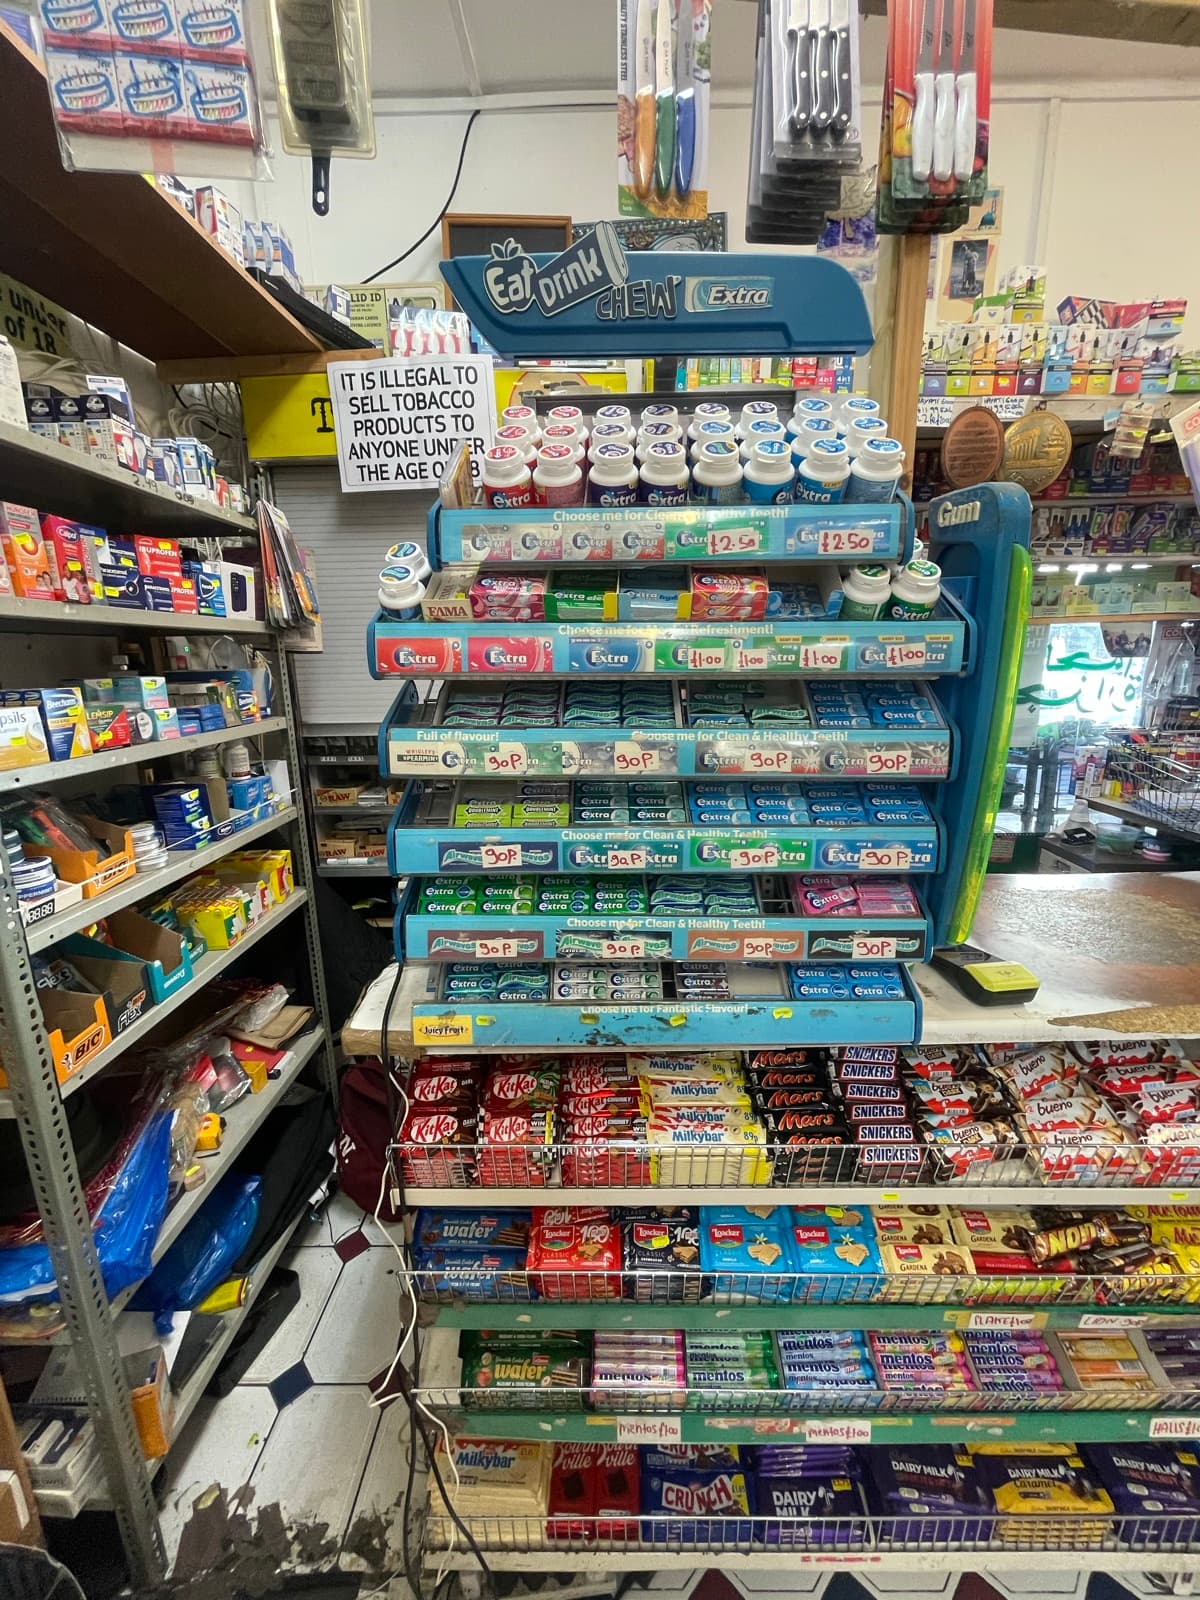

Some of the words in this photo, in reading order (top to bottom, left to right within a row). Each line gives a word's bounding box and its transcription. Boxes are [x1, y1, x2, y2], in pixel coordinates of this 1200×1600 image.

[486, 260, 534, 306] Eat
[538, 248, 603, 308] Drink
[351, 293, 367, 302] LID
[371, 293, 382, 302] ID
[596, 275, 682, 320] CHEW
[707, 285, 769, 306] Extra
[4, 316, 25, 341] of
[341, 373, 357, 391] IT
[361, 371, 376, 390] IS
[380, 366, 451, 388] ILLEGAL
[454, 365, 478, 386] TO
[349, 396, 390, 415] SELL
[392, 390, 475, 412] TOBACCO
[353, 415, 446, 437] PRODUCTS
[450, 413, 475, 433] TO
[349, 439, 420, 460] ANYONE
[357, 464, 391, 483] THE
[394, 462, 429, 481] AGE
[553, 510, 595, 522] Choose
[599, 513, 620, 521] me
[624, 510, 643, 521] for
[937, 500, 981, 528] Gum
[710, 533, 756, 554] £2.50
[822, 531, 870, 552] £2.50
[139, 545, 178, 558] IBUPROFEN
[767, 653, 796, 662] xtra
[884, 711, 915, 720] extra
[417, 731, 437, 741] Full
[455, 731, 499, 742] flavour!
[677, 733, 695, 741] me
[698, 731, 715, 741] for
[717, 731, 750, 741] Clean
[752, 732, 761, 741] &
[763, 731, 809, 743] Healthy
[810, 731, 848, 742] Teeth!
[871, 797, 900, 806] extra
[637, 811, 666, 820] extra
[701, 812, 731, 822] extra
[562, 831, 602, 841] Choose
[643, 830, 674, 840] Clean
[677, 830, 685, 839] &
[688, 829, 733, 840] Healthy
[485, 886, 513, 896] extra
[428, 903, 456, 912] extra
[594, 901, 623, 910] extra
[567, 918, 606, 928] Choose
[646, 918, 677, 929] Clean
[678, 919, 686, 929] &
[688, 918, 729, 930] Healthy
[732, 918, 766, 929] Teeth!
[500, 991, 527, 1000] extra
[581, 1004, 620, 1014] Choose
[623, 1006, 639, 1014] me
[641, 1004, 655, 1014] for
[656, 1003, 703, 1013] Fantastic
[75, 1030, 102, 1052] BIC
[752, 1050, 808, 1068] Mars
[846, 1046, 896, 1062] SNICKERS
[650, 1059, 696, 1075] Milkybar
[843, 1063, 894, 1079] SNICKERS
[761, 1071, 816, 1087] Mars
[931, 1082, 962, 1092] bueno
[418, 1076, 457, 1101] KitKat
[498, 1075, 536, 1100] KitKat
[671, 1084, 719, 1100] Milkybar
[848, 1084, 899, 1099] SNICKERS
[768, 1090, 824, 1108] Mars
[677, 1109, 726, 1124] Milkybar
[854, 1104, 905, 1119] SNICKERS
[778, 1111, 835, 1130] Mars
[416, 1116, 457, 1143] KitKat
[494, 1116, 527, 1142] KitKat
[860, 1124, 912, 1140] SNICKERS
[951, 1126, 980, 1142] bueno
[672, 1130, 724, 1145] Milkybar
[442, 1223, 493, 1240] wafer
[543, 1228, 571, 1238] Loacker
[711, 1227, 741, 1238] Loacker
[796, 1228, 826, 1239] Loacker
[881, 1233, 908, 1242] GARDENA
[541, 1251, 570, 1259] CLASSIC
[899, 1263, 928, 1272] GARDENA
[880, 1353, 933, 1364] mentos
[972, 1354, 1025, 1367] mentos
[494, 1361, 547, 1381] wafer
[692, 1369, 744, 1380] mentos
[787, 1361, 840, 1373] mentos
[456, 1451, 516, 1470] Milkybar
[562, 1453, 594, 1470] ville
[605, 1450, 637, 1467] ville
[1112, 1456, 1145, 1470] DAIRY
[1146, 1462, 1173, 1474] MILK
[892, 1461, 922, 1473] DAIRY
[923, 1465, 948, 1479] MILK
[1008, 1468, 1037, 1479] DAIRY
[1038, 1468, 1060, 1478] MILK
[664, 1475, 733, 1511] CRUNCH
[772, 1490, 817, 1506] DAIRY
